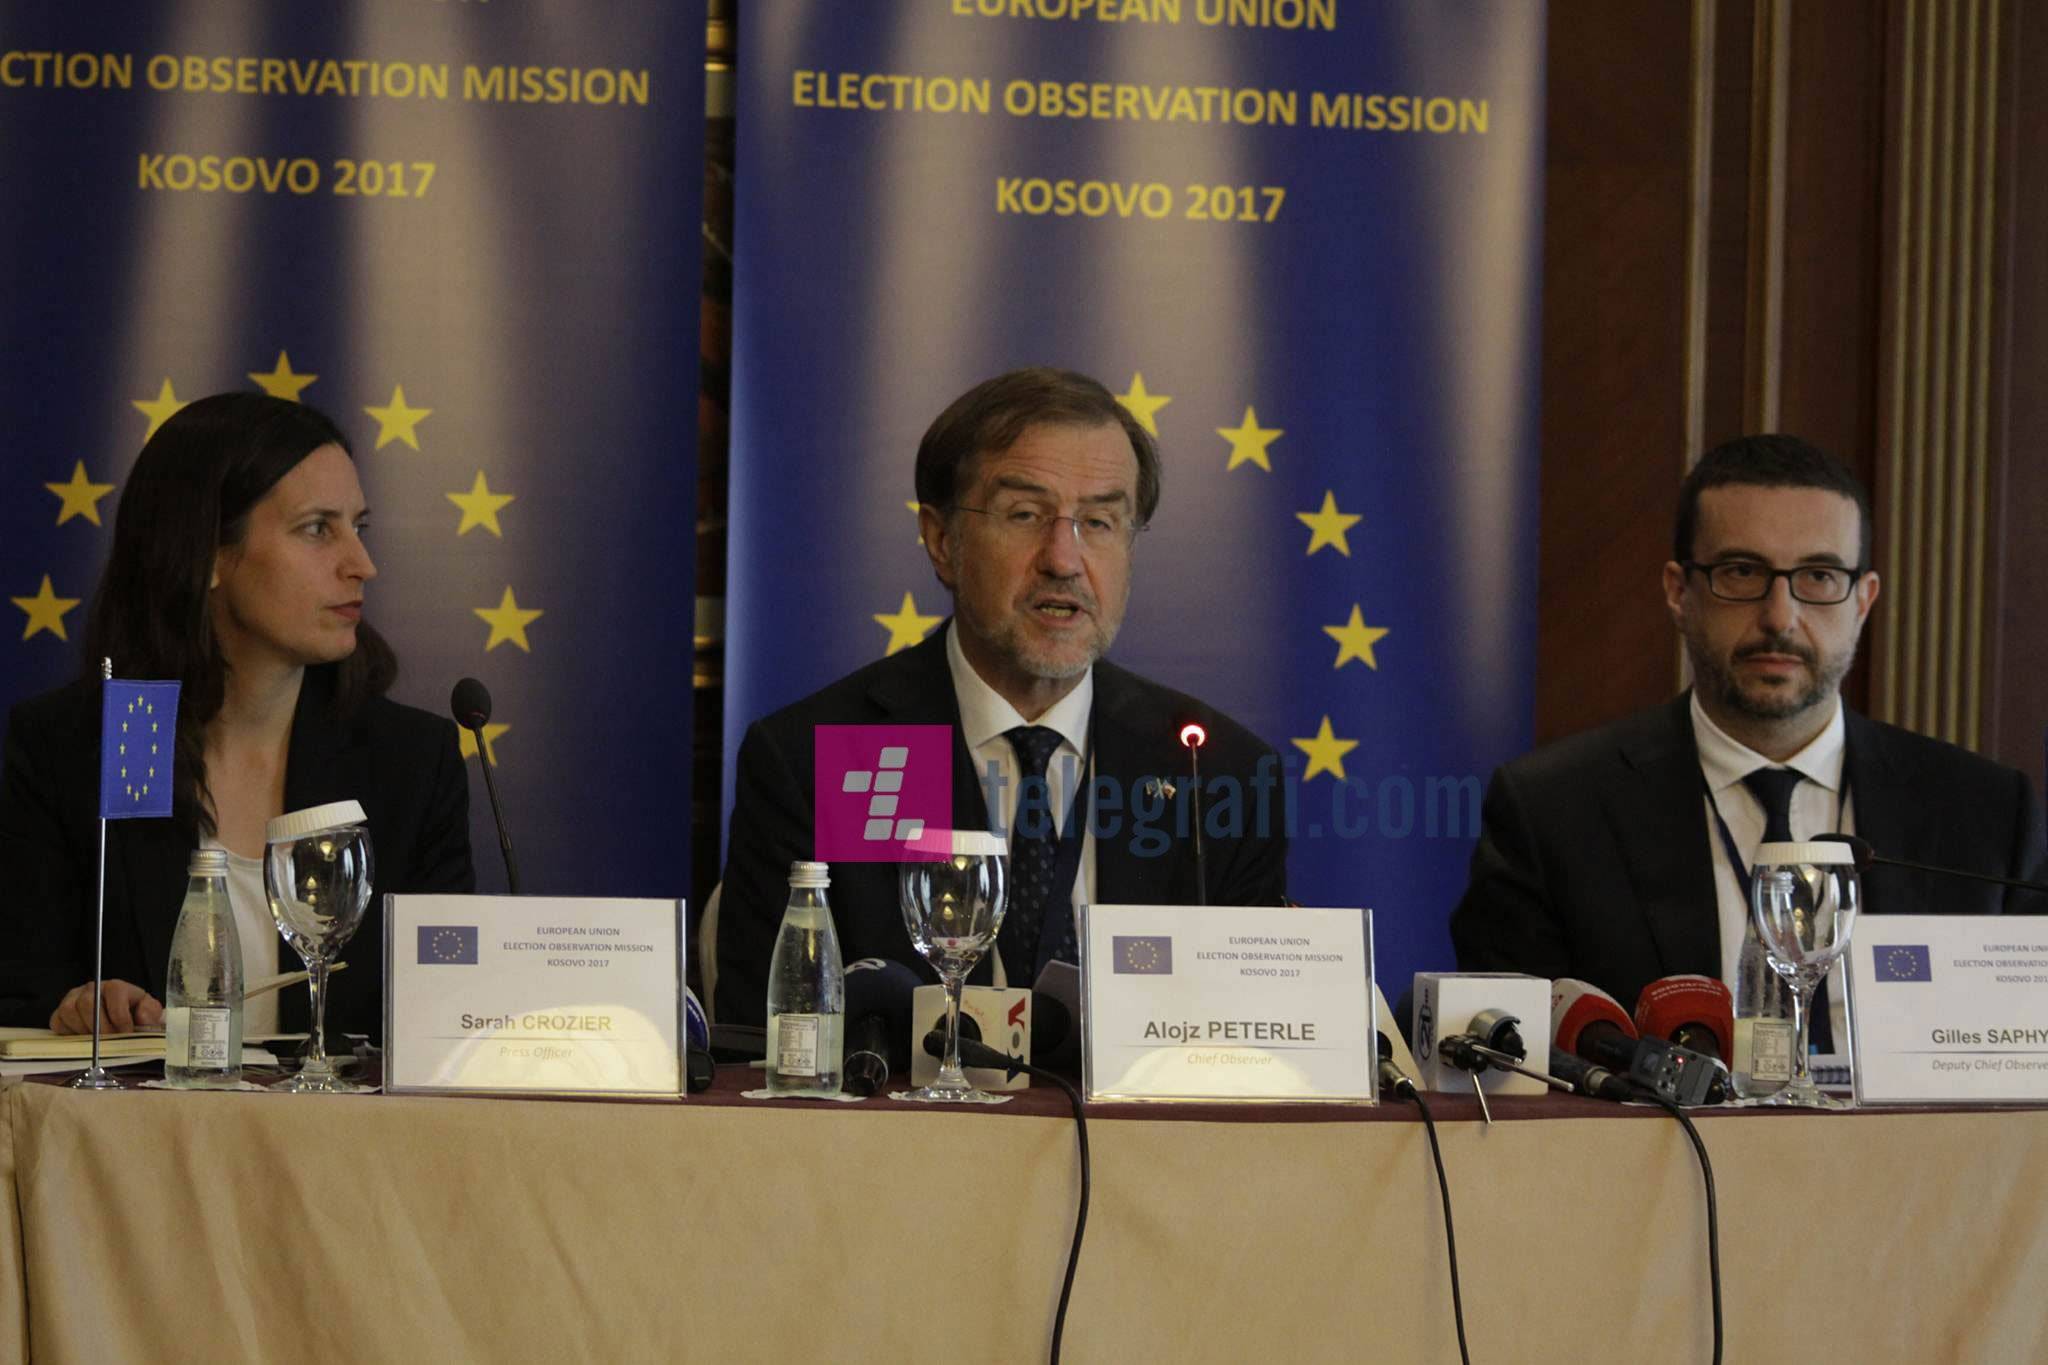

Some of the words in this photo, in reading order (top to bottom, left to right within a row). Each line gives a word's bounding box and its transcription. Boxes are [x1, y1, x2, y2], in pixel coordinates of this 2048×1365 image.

[1197, 0, 1336, 29] UNION
[0, 50, 133, 90] CTION
[146, 54, 449, 99] OBSERVATION
[463, 66, 649, 104] MISSION
[792, 71, 991, 114] ELECTION
[1003, 80, 1297, 126] OBSERVATION
[1310, 93, 1489, 133] MISSION
[138, 153, 320, 194] KOSOVO
[333, 160, 436, 198] 2017
[996, 177, 1173, 219] KOSOVO
[1185, 186, 1286, 223] 2017
[536, 926, 586, 937] EUROPEAN
[588, 927, 620, 937] UNION
[503, 942, 546, 951] ELECTION
[548, 942, 612, 952] OBSERVATION
[614, 944, 654, 953] MISSION
[1228, 936, 1278, 945] EUROPEAN
[1279, 937, 1311, 946] UNION
[1982, 944, 2030, 953] EUROPEAN
[547, 958, 586, 968] KOSOVO
[588, 959, 610, 968] 2017
[1196, 951, 1239, 961] ELECTION
[1240, 952, 1303, 962] OBSERVATION
[1304, 953, 1344, 962] MISSION
[1952, 959, 1994, 968] ELECTION
[1239, 967, 1278, 977] KOSOVO
[1279, 968, 1301, 978] 2017
[1995, 975, 2031, 984] KOSOVO
[460, 1013, 516, 1031] Sarah
[522, 1014, 612, 1031] CROZIER
[1143, 1020, 1201, 1043] Alojz
[1207, 1020, 1317, 1041] PETERLE
[1931, 1028, 1982, 1044] Gilles
[1987, 1028, 2048, 1044] SAPHY
[500, 1046, 530, 1058] Press
[533, 1046, 573, 1060] Officer
[1186, 1053, 1218, 1066] Chief
[1220, 1053, 1273, 1066] Observer
[1931, 1059, 1972, 1072] Deputy
[1974, 1058, 2002, 1072] Chief
[2004, 1059, 2048, 1071] Observe
